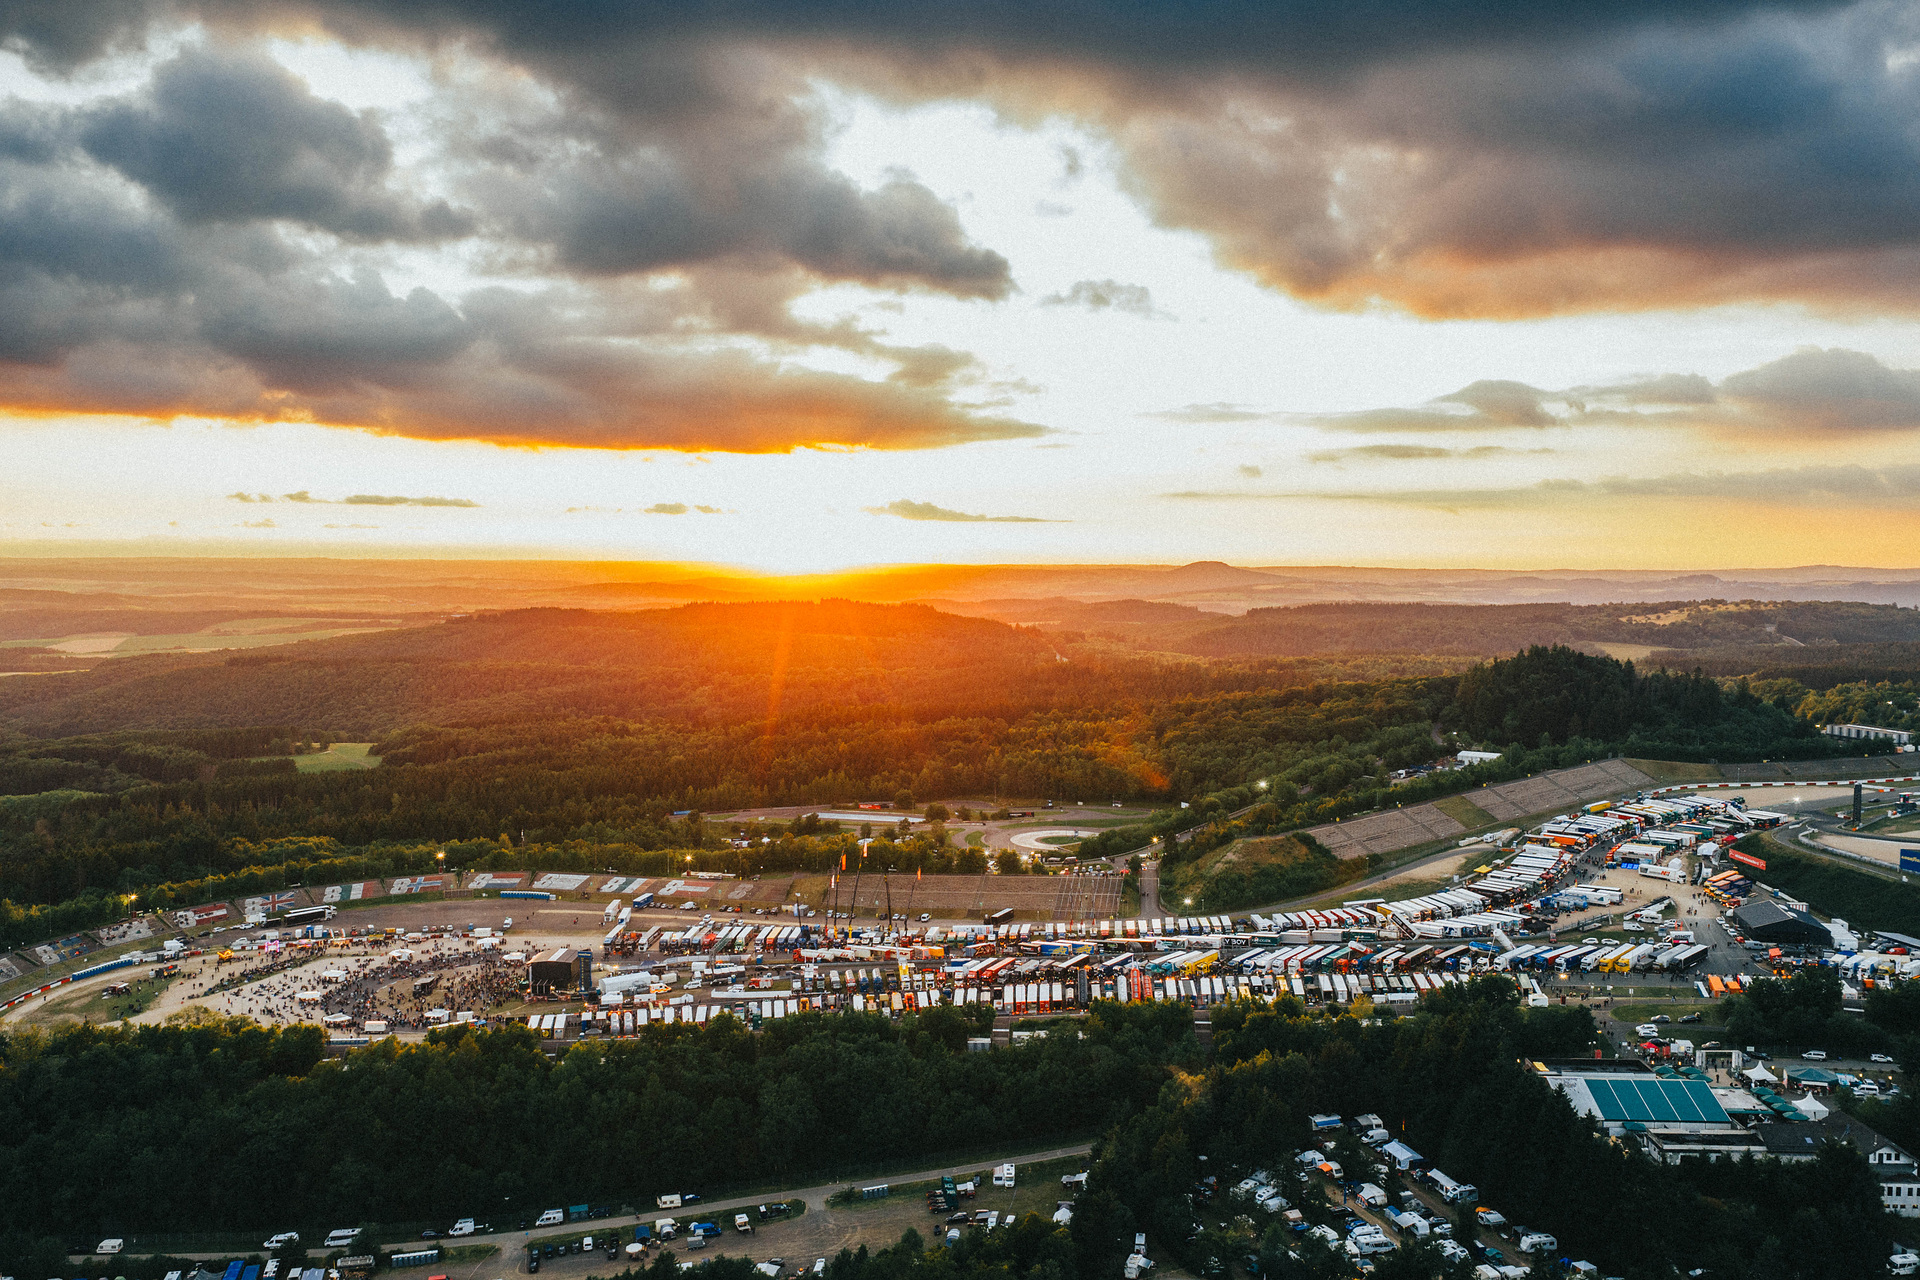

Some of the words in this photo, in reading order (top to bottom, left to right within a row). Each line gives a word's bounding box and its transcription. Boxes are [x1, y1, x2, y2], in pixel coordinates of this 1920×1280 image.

[390, 878, 411, 894] 8
[468, 873, 493, 889] 8
[599, 876, 626, 892] 8
[658, 880, 685, 896] 8
[323, 886, 342, 903] 8
